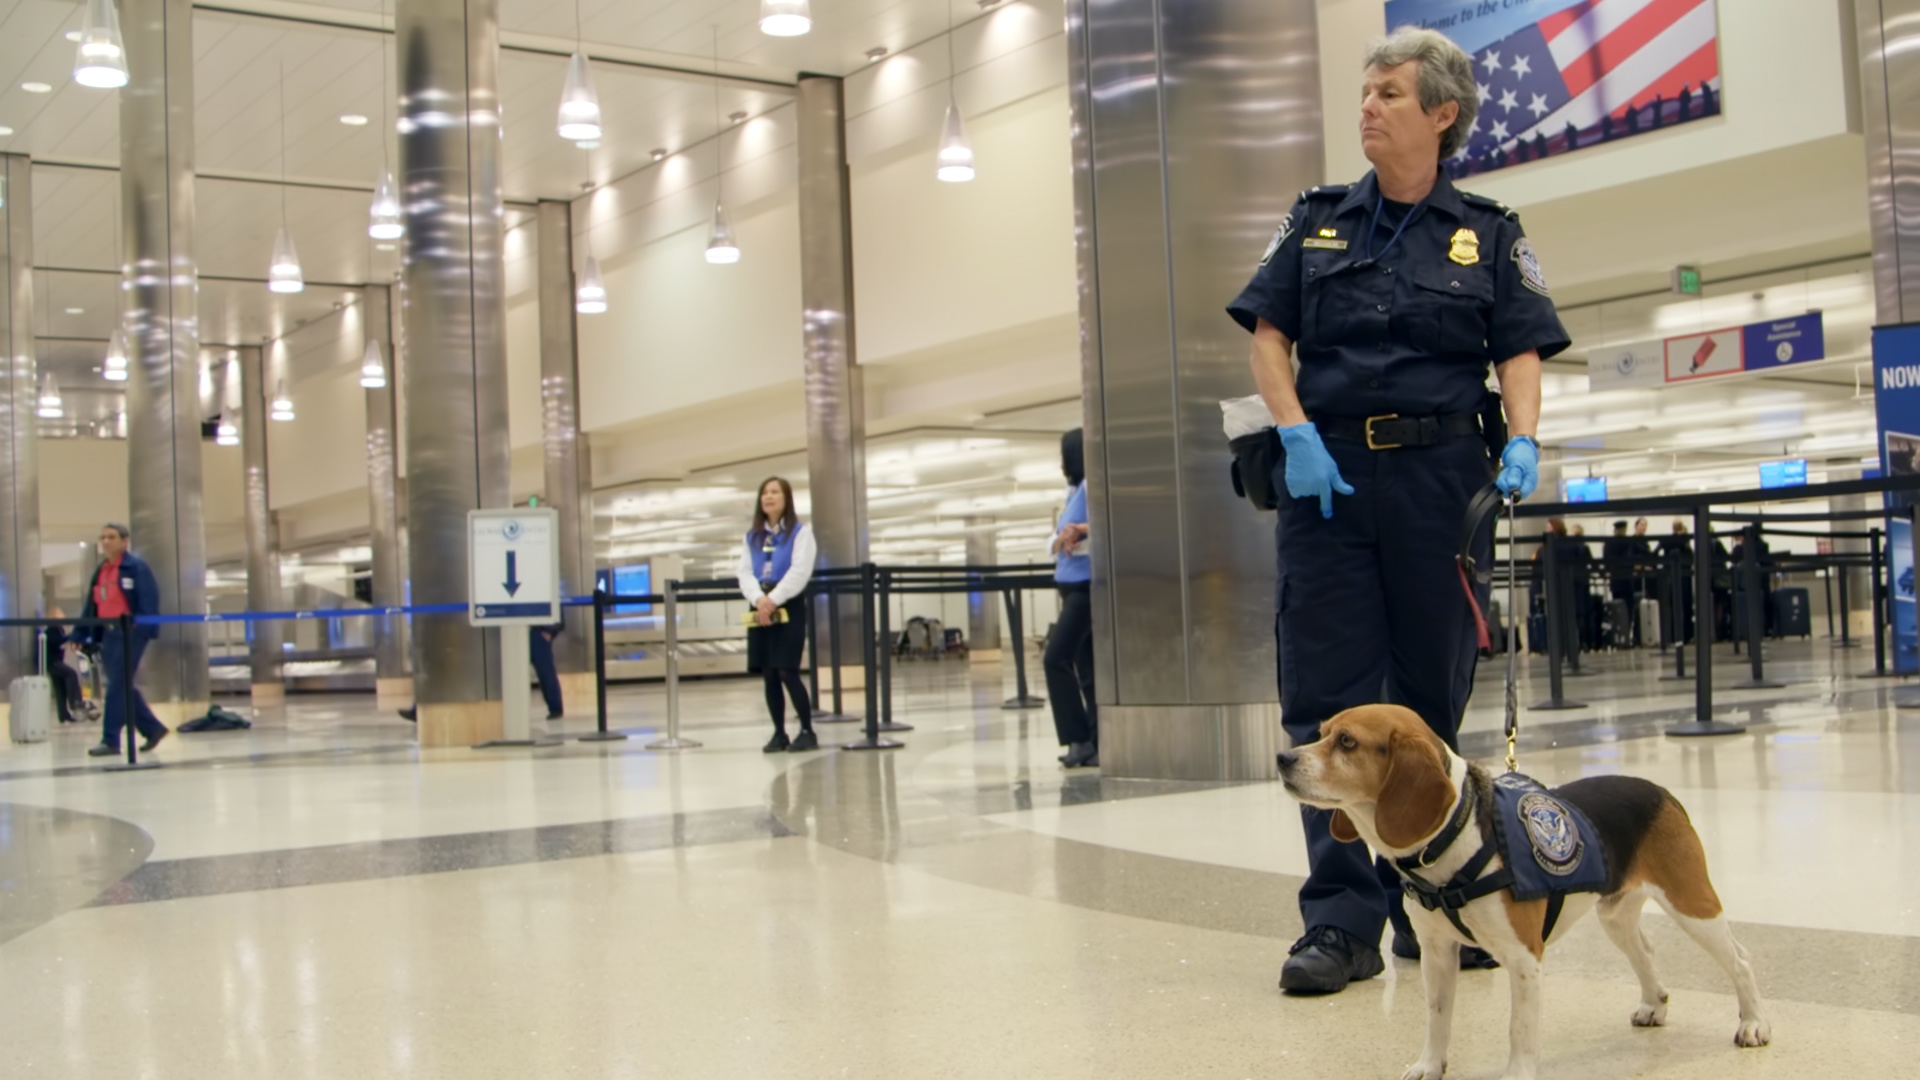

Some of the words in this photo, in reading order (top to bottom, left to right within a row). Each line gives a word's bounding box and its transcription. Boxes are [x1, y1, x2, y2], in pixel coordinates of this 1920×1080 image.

[1460, 8, 1474, 23] to
[1476, 1, 1498, 17] the
[1882, 364, 1920, 389] NOW
